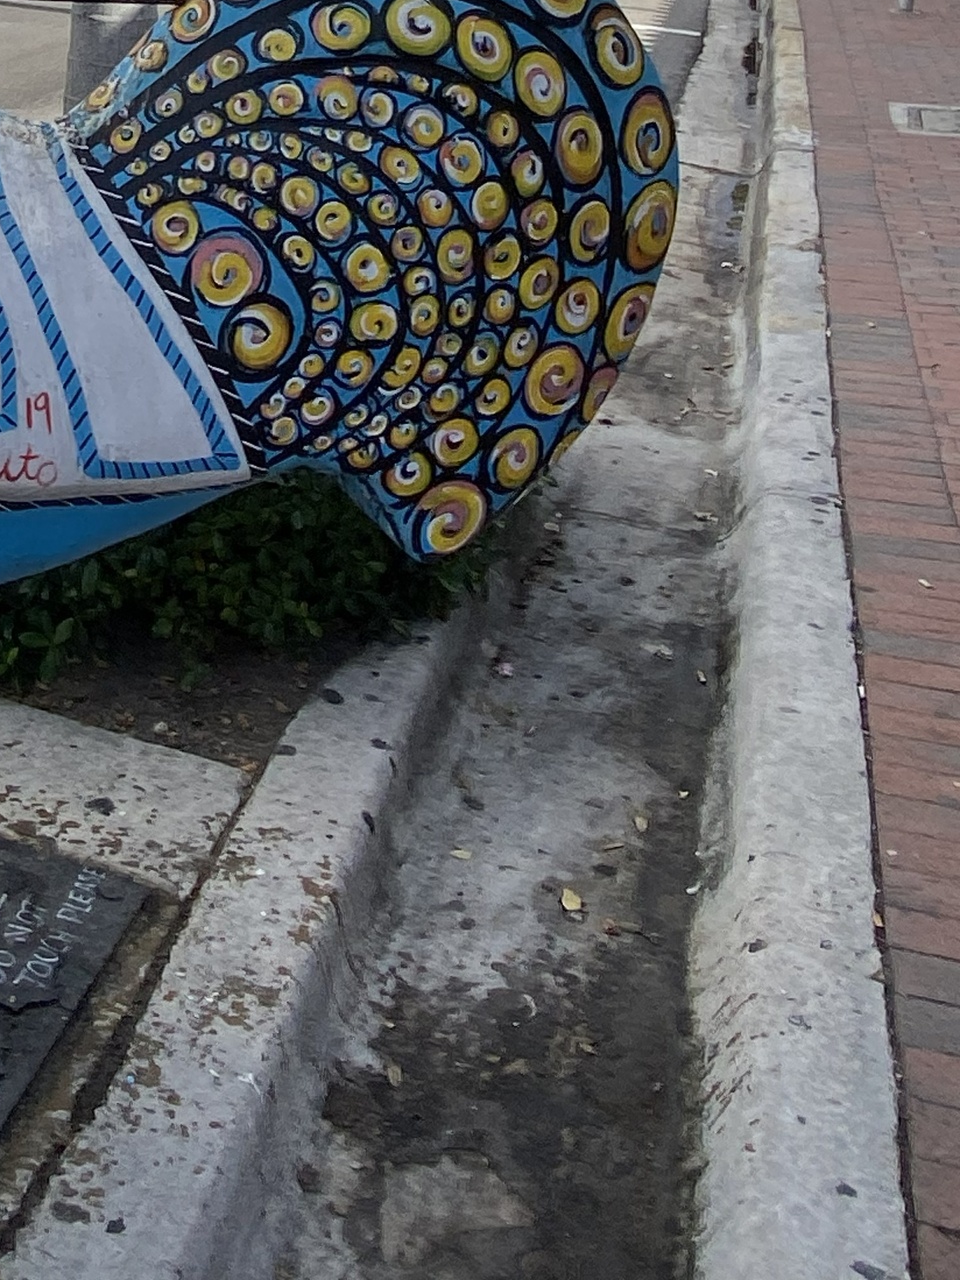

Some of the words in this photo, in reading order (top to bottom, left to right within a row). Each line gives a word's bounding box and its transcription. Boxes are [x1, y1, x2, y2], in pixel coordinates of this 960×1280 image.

[25, 391, 52, 434] 19
[13, 929, 78, 988] TOUCH
[56, 867, 107, 925] PLEASE
